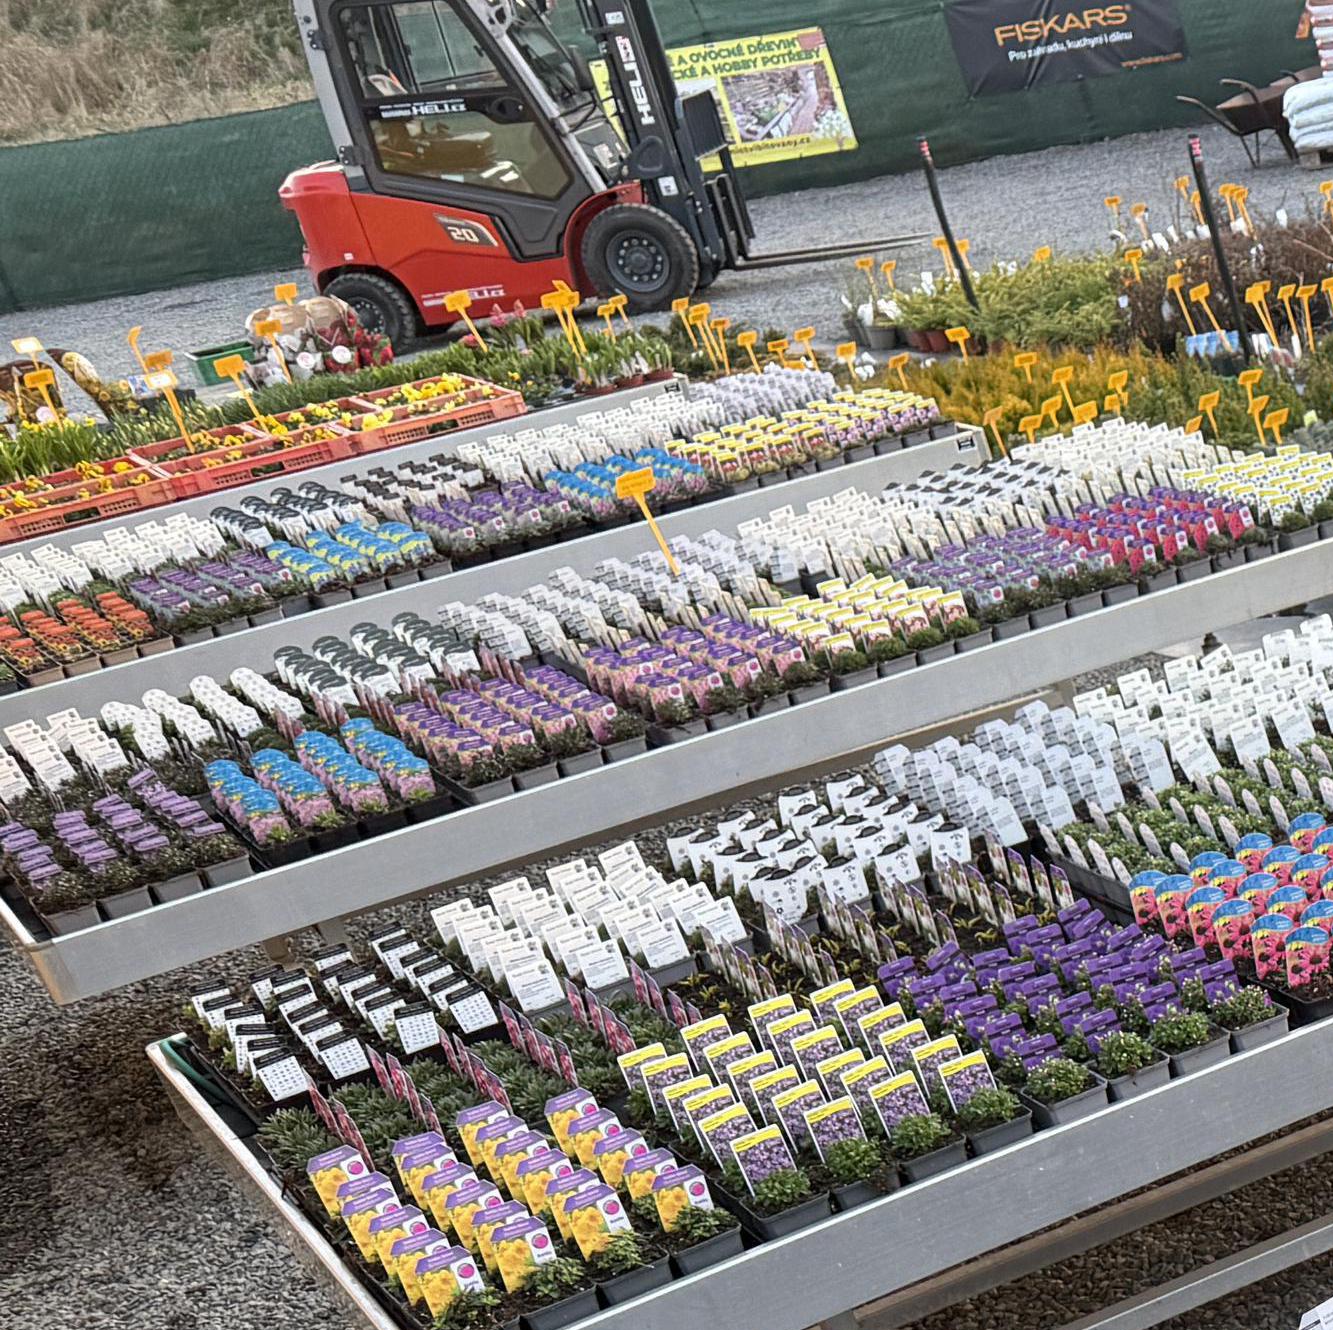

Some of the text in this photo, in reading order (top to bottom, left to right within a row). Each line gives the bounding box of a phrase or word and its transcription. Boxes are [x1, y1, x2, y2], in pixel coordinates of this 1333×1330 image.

[747, 37, 800, 54] DŘEVIN
[1008, 49, 1027, 62] Pro
[713, 58, 759, 75] HOBBY
[447, 226, 480, 243] 20
